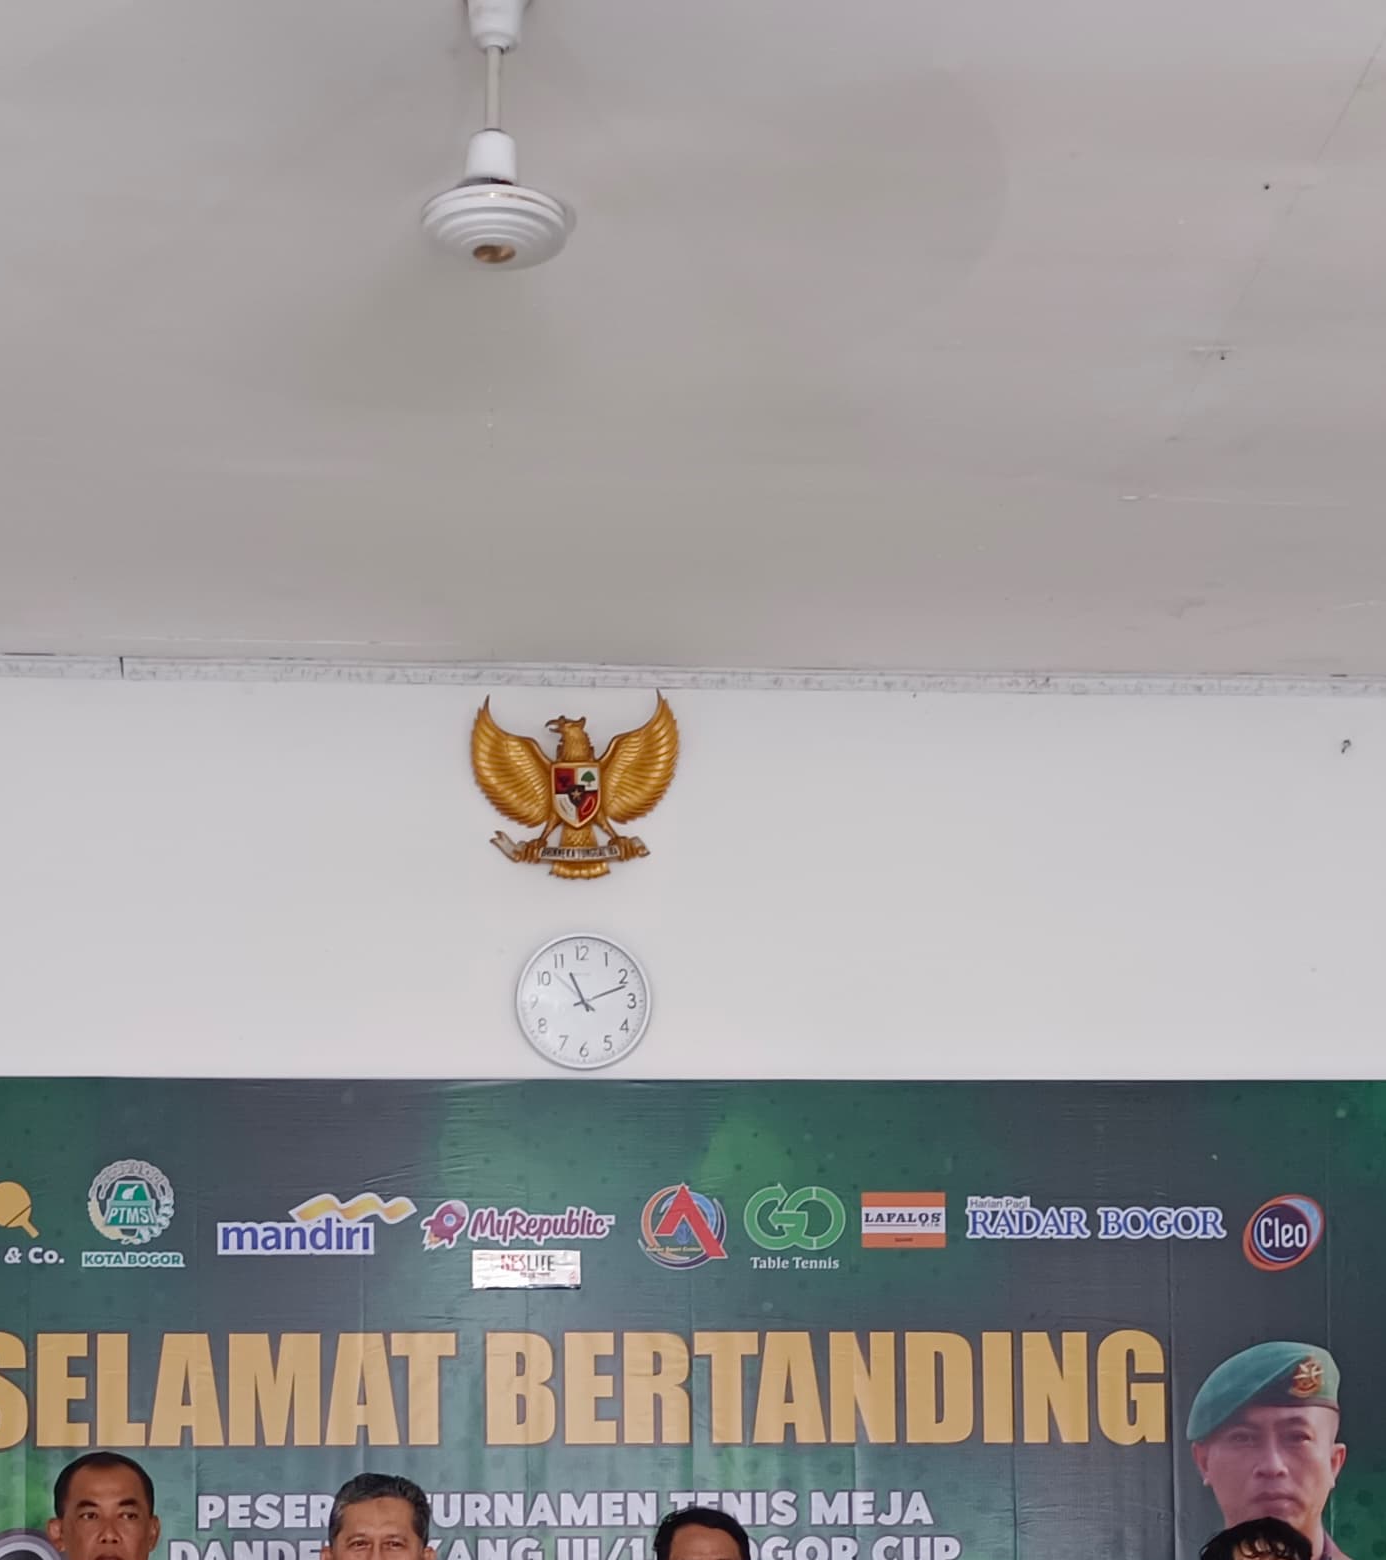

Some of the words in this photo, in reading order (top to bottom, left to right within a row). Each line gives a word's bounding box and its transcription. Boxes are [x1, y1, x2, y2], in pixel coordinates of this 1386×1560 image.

[554, 953, 564, 969] 11
[575, 945, 589, 961] 12
[604, 952, 609, 968] 1
[537, 971, 551, 986] 10
[618, 968, 629, 985] 2
[627, 993, 637, 1010] 3
[538, 1017, 548, 1034] 8
[619, 1018, 630, 1034] 4
[559, 1035, 570, 1051] 7
[579, 1041, 590, 1058] 6
[603, 1035, 613, 1052] 5
[970, 1198, 1002, 1208] Harian
[1004, 1198, 1028, 1210] Pagi
[107, 1206, 156, 1224] PTMSI
[968, 1209, 1088, 1237] RADAR
[1099, 1208, 1225, 1237] BOGOR
[221, 1217, 370, 1251] mandiri
[470, 1208, 607, 1243] MyRepublic
[1260, 1217, 1308, 1248] Cleo
[4, 1247, 21, 1265] &
[28, 1247, 65, 1265] Co.
[84, 1253, 123, 1265] KOTA
[127, 1253, 181, 1265] BOGOR
[750, 1256, 790, 1270] Table
[792, 1256, 840, 1270] Tennis
[485, 1330, 1166, 1446] BERTANDING
[426, 1492, 657, 1528] URNAMEN
[811, 1491, 933, 1526] MEJA
